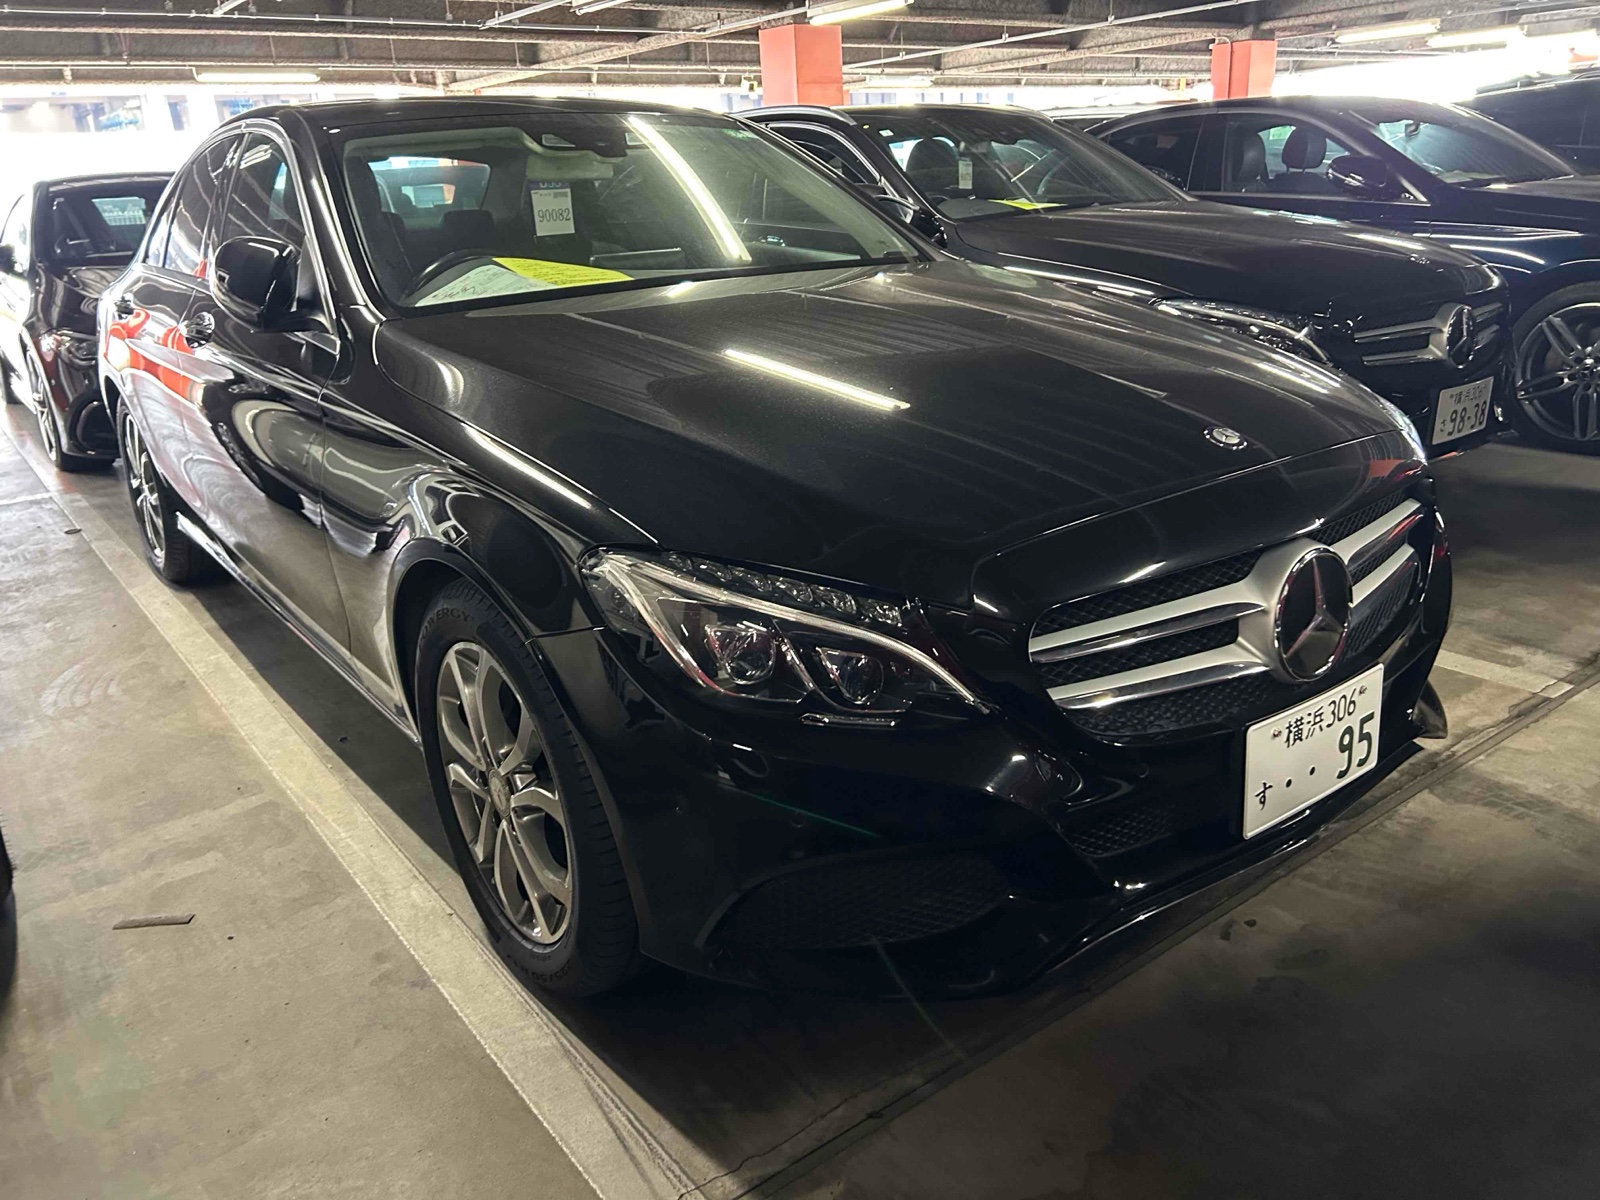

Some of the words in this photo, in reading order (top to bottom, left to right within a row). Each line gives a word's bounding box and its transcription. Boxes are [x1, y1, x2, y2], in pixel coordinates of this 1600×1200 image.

[537, 207, 571, 223] 90082
[1447, 400, 1487, 436] 98-38
[1255, 782, 1273, 810] す
